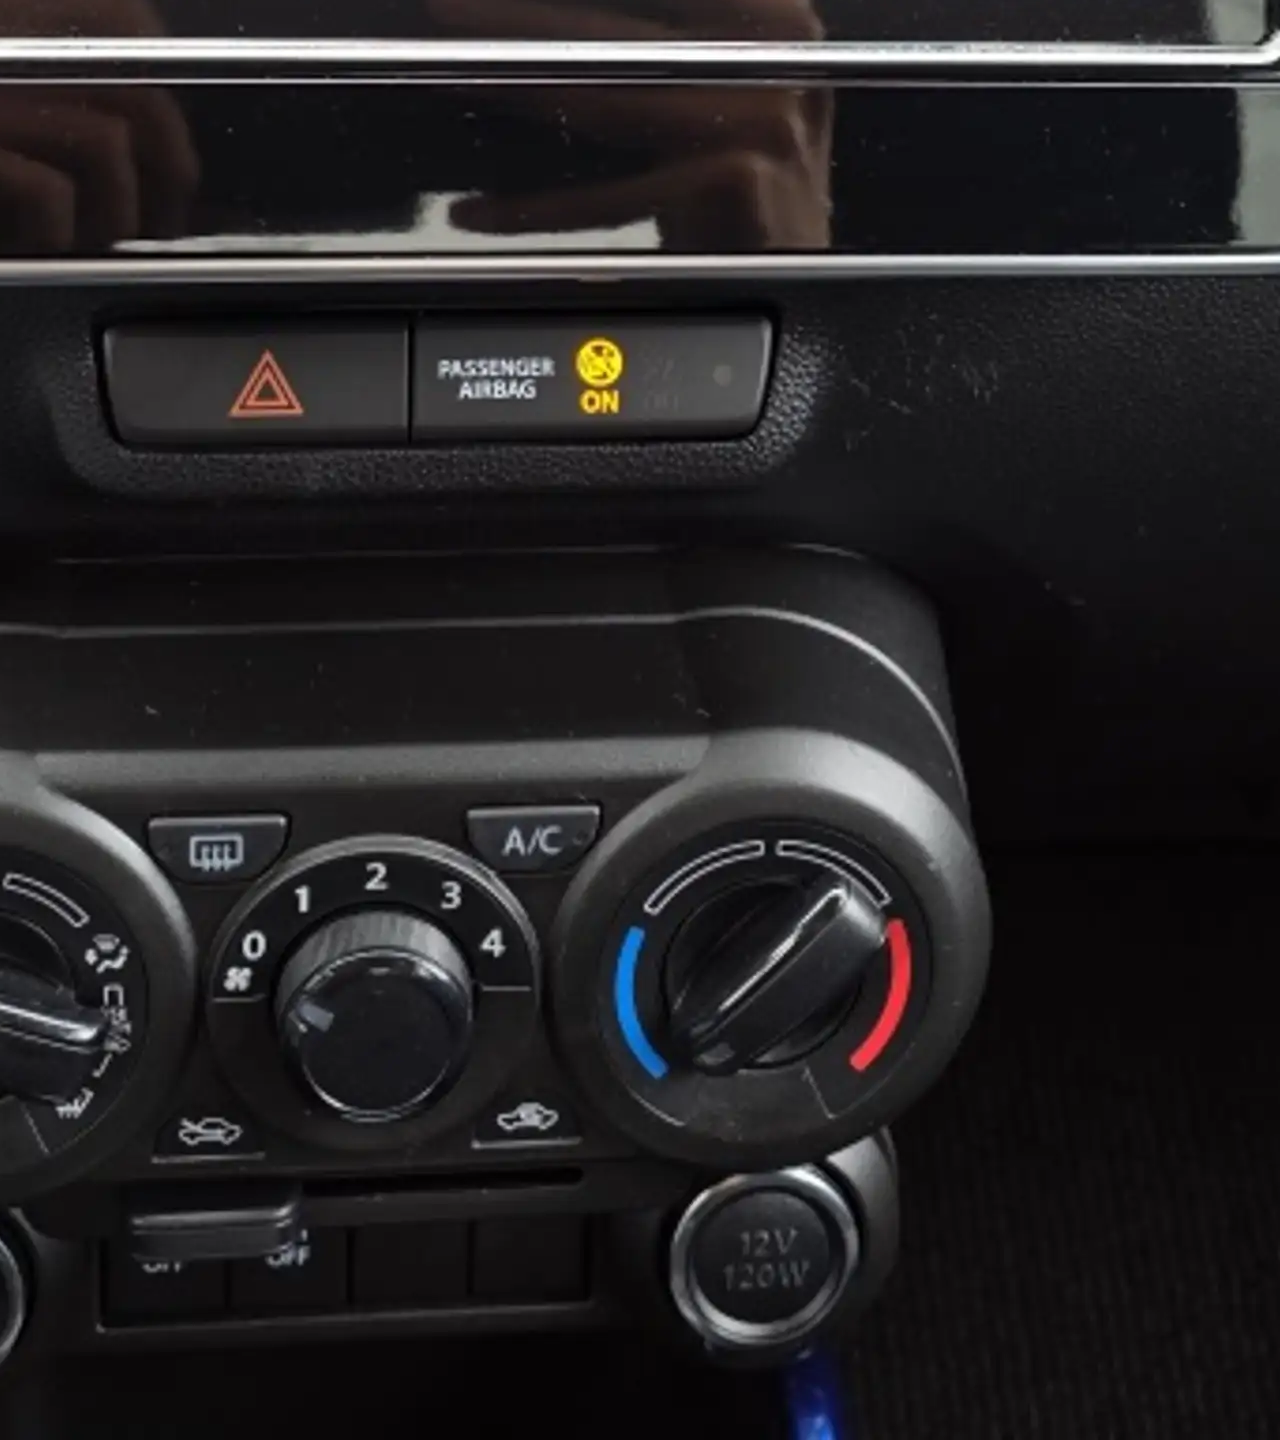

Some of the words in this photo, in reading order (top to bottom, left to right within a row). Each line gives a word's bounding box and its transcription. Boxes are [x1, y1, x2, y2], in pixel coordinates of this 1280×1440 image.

[437, 357, 556, 379] PASSENGER
[458, 378, 538, 400] AIRBAG
[579, 389, 620, 414] ON
[502, 825, 562, 856] A/C
[241, 930, 268, 961] 0
[293, 885, 311, 914] 1
[364, 861, 389, 891] 2
[440, 880, 463, 910] 3
[479, 928, 507, 958] 4
[739, 1227, 798, 1257] 12V
[723, 1259, 811, 1292] 120W
